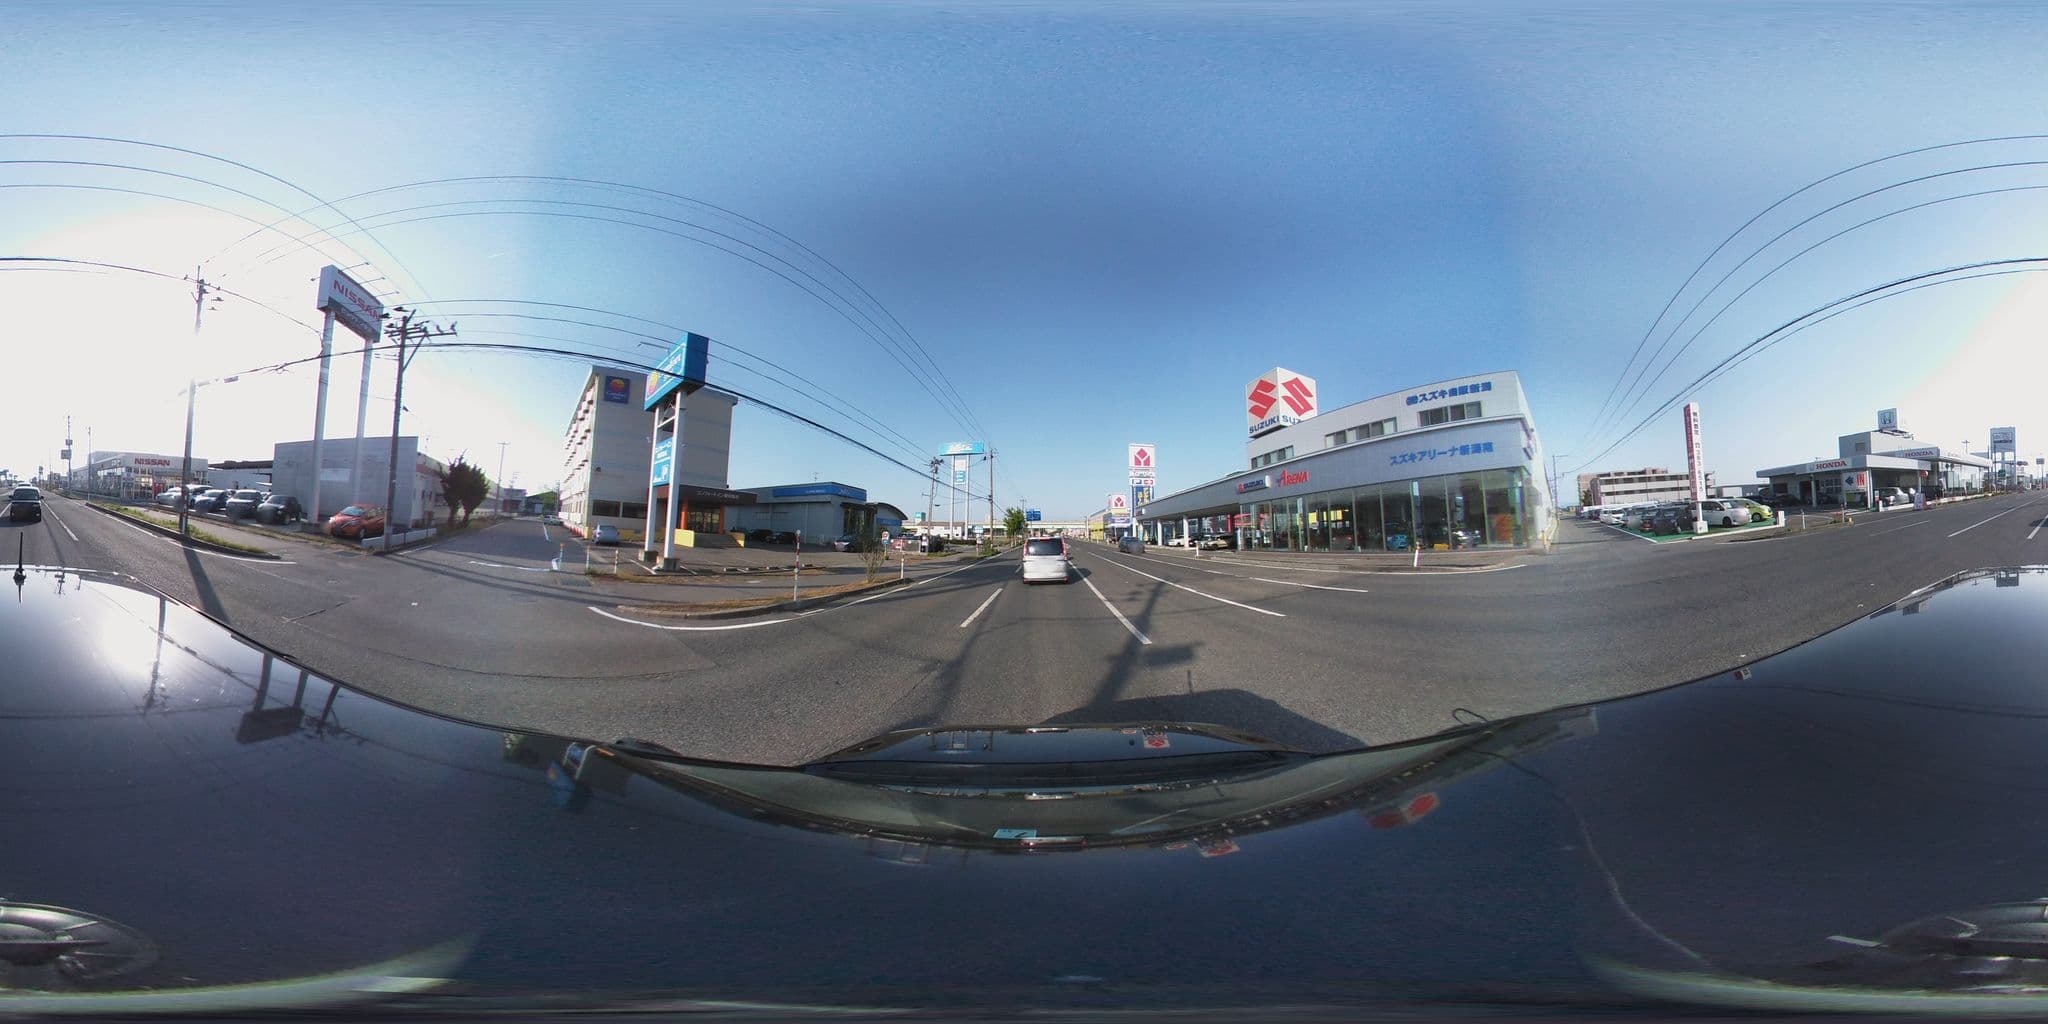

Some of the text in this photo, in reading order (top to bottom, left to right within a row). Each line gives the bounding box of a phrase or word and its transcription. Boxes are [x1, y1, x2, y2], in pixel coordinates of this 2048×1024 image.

[334, 280, 380, 321] NISSAN
[1249, 416, 1280, 434] SUZUKI
[1905, 450, 1934, 458] HONDA
[135, 458, 171, 466] NISSAN
[1816, 461, 1847, 470] HONDA
[1857, 473, 1865, 486] IN
